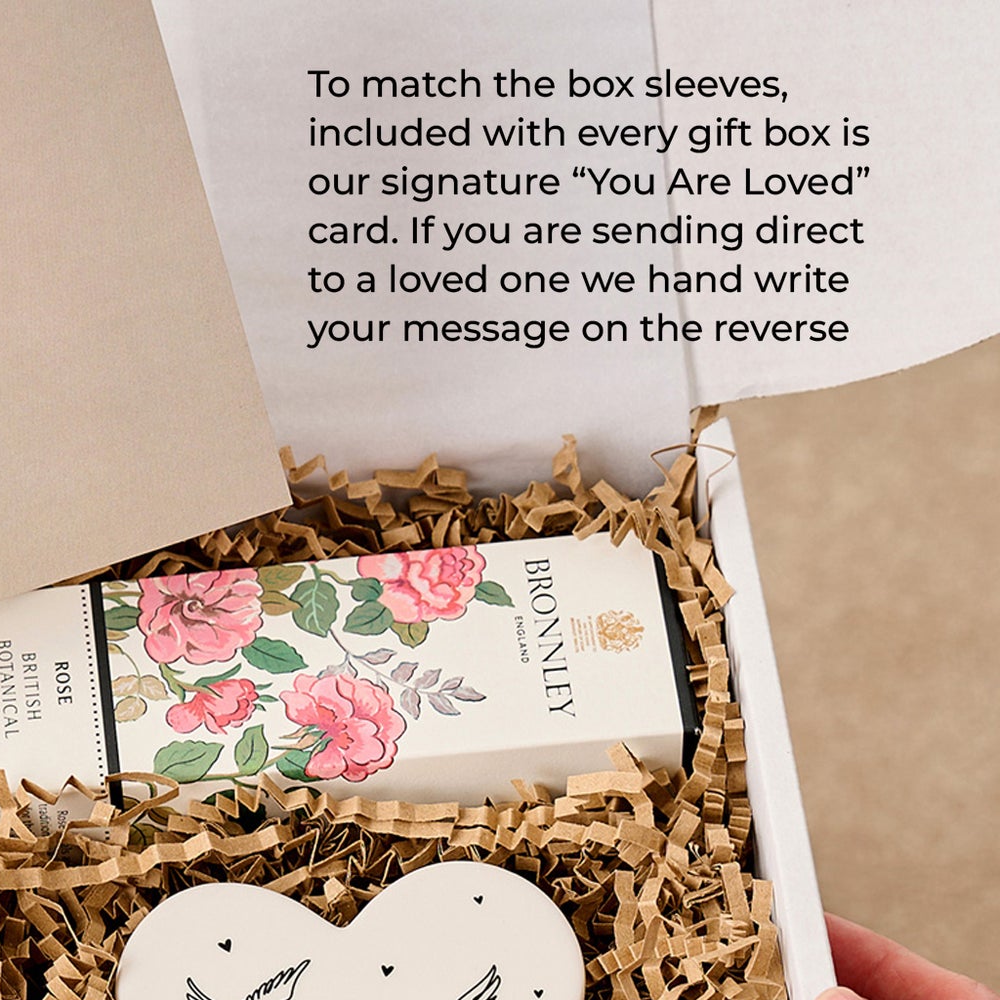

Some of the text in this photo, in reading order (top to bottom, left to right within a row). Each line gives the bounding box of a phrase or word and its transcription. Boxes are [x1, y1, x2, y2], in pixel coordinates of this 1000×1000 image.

[514, 615, 530, 664] ENGLAND
[523, 558, 576, 718] BRONNLEY
[21, 652, 42, 721] BRITISH
[54, 661, 73, 706] ROSE
